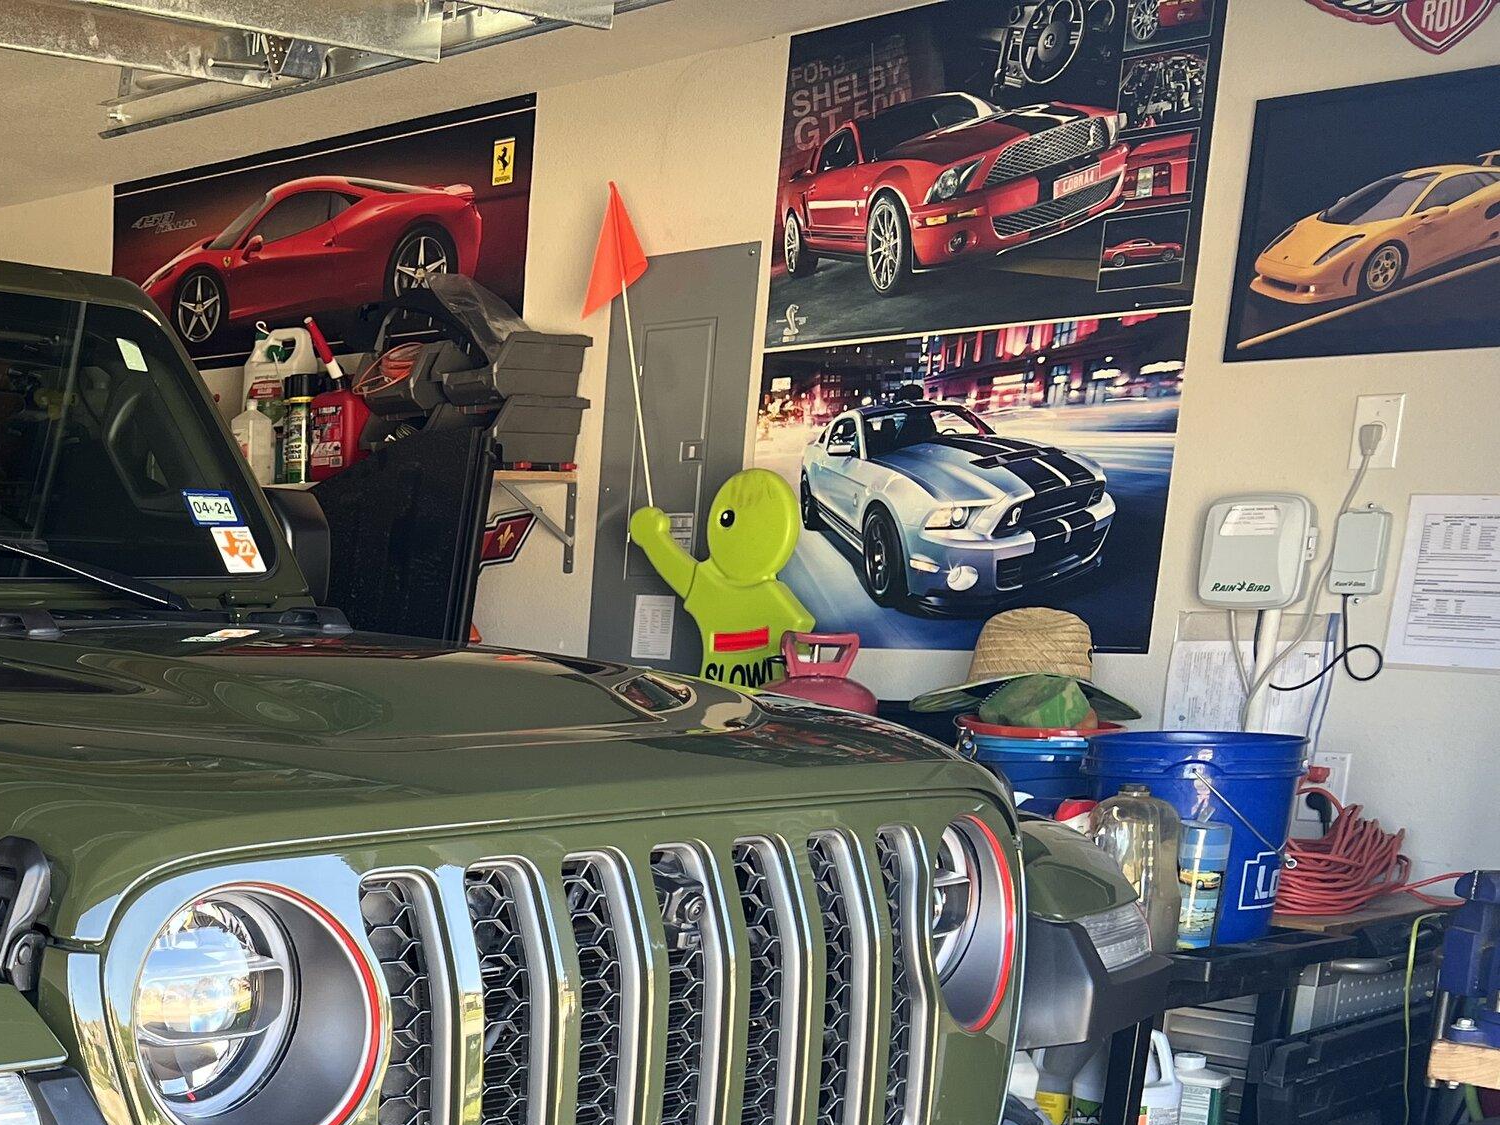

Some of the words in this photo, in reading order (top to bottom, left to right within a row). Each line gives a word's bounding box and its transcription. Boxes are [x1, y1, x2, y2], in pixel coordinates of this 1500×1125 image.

[794, 106, 842, 150] GT
[1211, 582, 1237, 592] RAIN
[1246, 581, 1271, 592] BIRD
